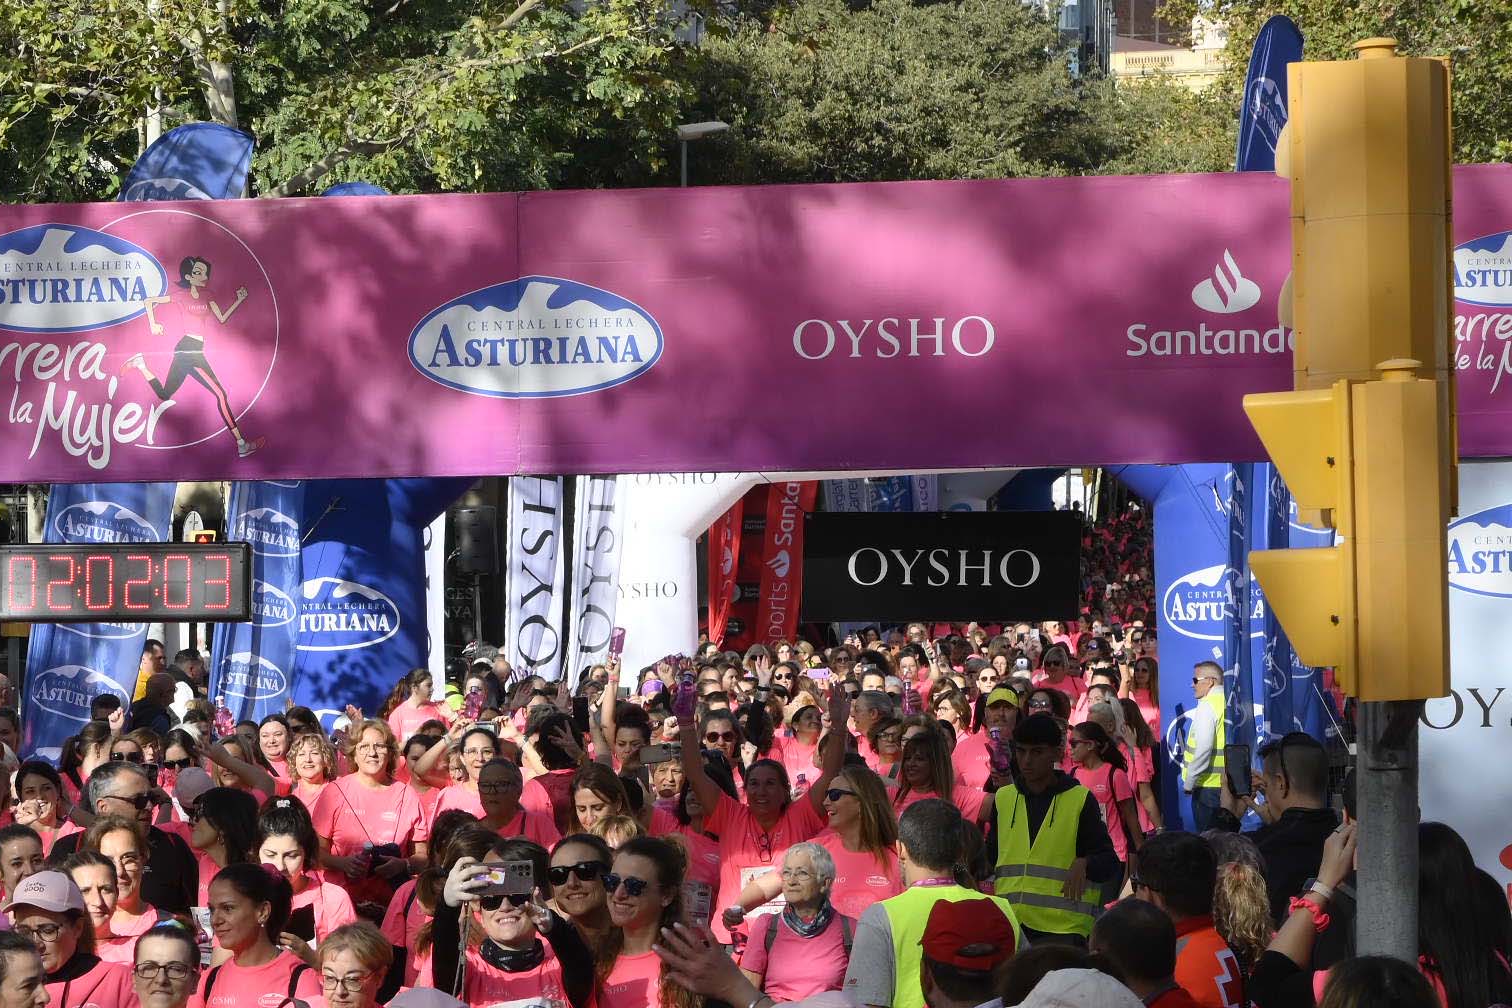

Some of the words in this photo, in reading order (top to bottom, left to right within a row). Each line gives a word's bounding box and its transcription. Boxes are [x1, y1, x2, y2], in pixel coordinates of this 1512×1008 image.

[71, 260, 143, 272] LECHERA
[1467, 257, 1512, 266] CENTRA
[467, 318, 546, 332] CENTRAL
[554, 316, 635, 330] LECHERA
[792, 315, 995, 360] OYSHO
[1454, 312, 1512, 342] arre
[428, 323, 643, 368] ASTURIANA
[1476, 341, 1494, 370] la
[9, 385, 33, 424] la
[29, 375, 176, 470] Mujer
[774, 481, 802, 546] Santa
[1474, 535, 1512, 545] CENT
[517, 476, 560, 668] OYSH
[578, 477, 616, 654] OYSH
[848, 547, 1041, 588] OYSHO
[8, 555, 231, 610] 02:02:03
[617, 580, 678, 600] YSHO
[253, 600, 289, 620] RIANA
[302, 602, 332, 611] NTRAL
[299, 612, 391, 633] TURIANA
[37, 681, 93, 708] ASTURI
[1419, 688, 1512, 730] OY
